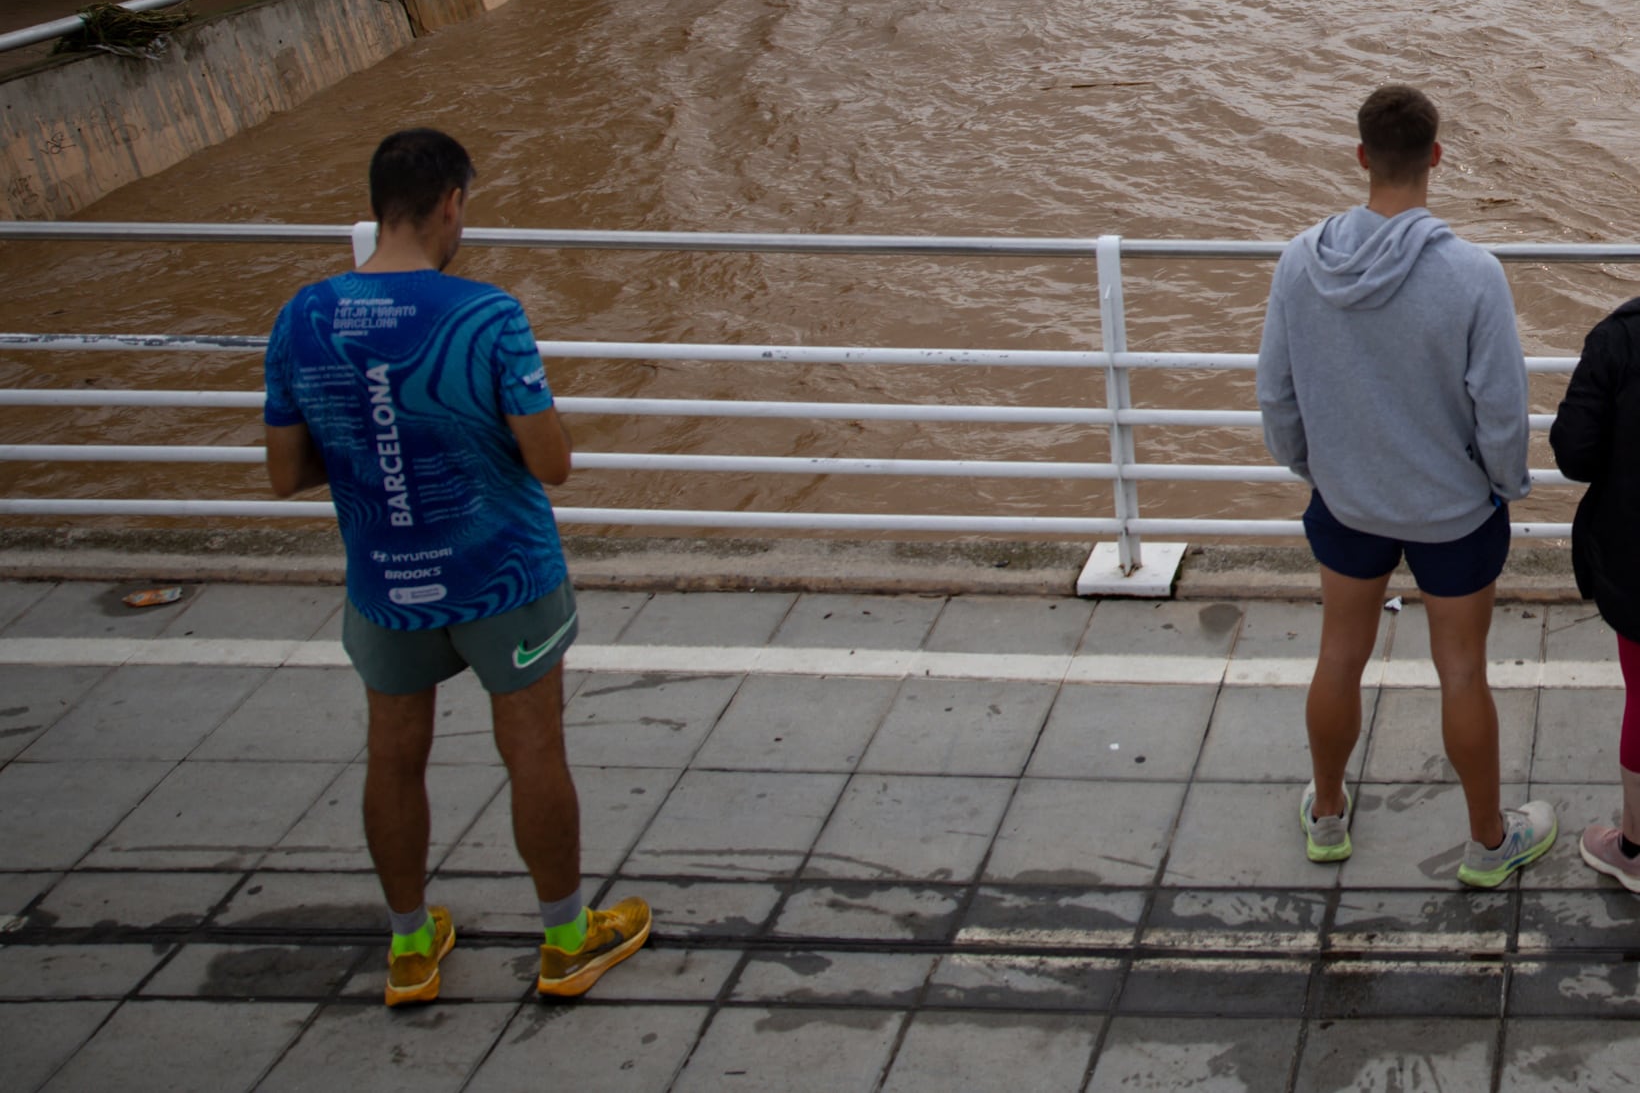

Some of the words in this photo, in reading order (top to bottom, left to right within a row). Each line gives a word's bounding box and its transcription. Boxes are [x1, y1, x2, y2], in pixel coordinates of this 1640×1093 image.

[333, 318, 397, 329] BARCELONA
[366, 363, 413, 526] BARCELONA
[392, 547, 453, 562] HYUNDAI
[384, 566, 441, 580] BROOKS
